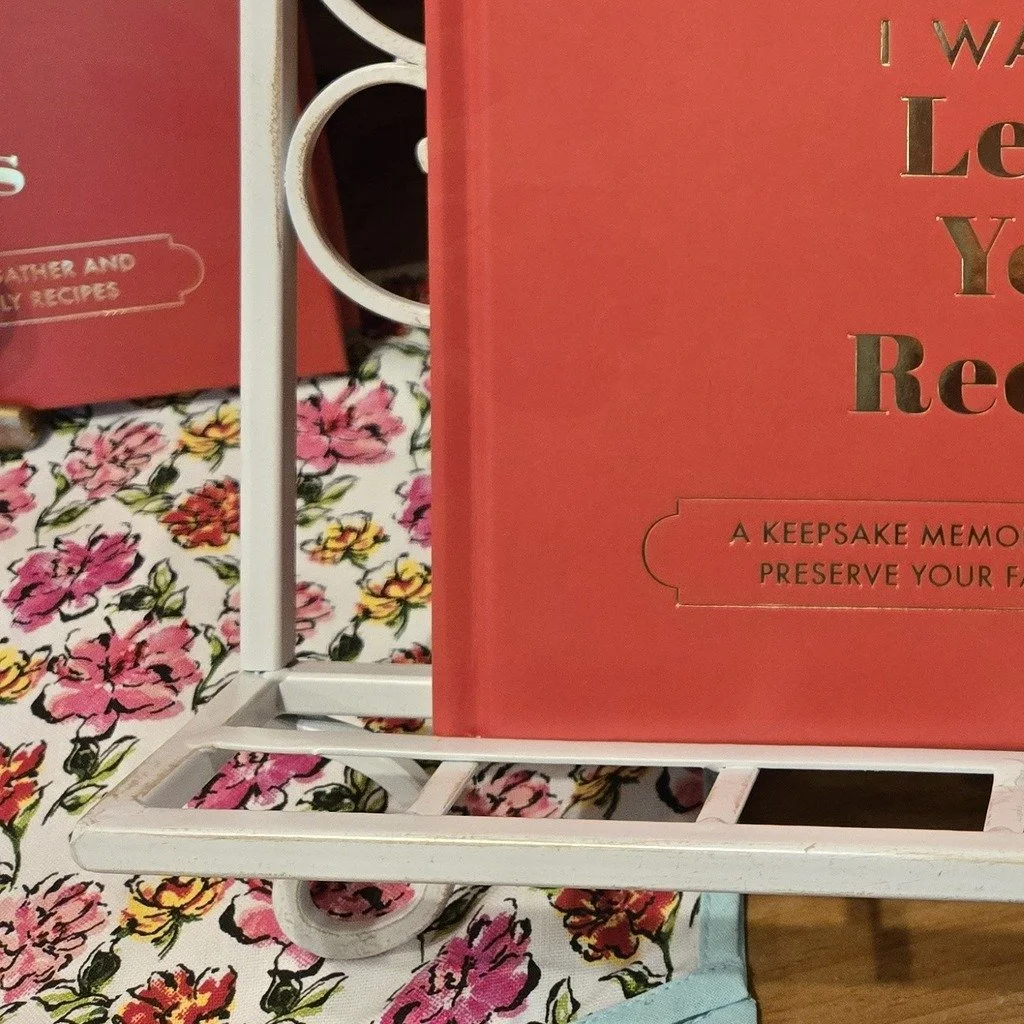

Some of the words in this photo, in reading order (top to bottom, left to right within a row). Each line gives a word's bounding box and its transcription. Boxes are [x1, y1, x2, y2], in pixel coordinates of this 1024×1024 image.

[879, 19, 891, 67] I
[84, 253, 135, 276] AND
[30, 281, 120, 307] RECIPES
[729, 521, 751, 547] A
[762, 522, 909, 549] KEEPSAKE
[758, 562, 901, 590] PRESERVE
[911, 564, 995, 590] YOUR
